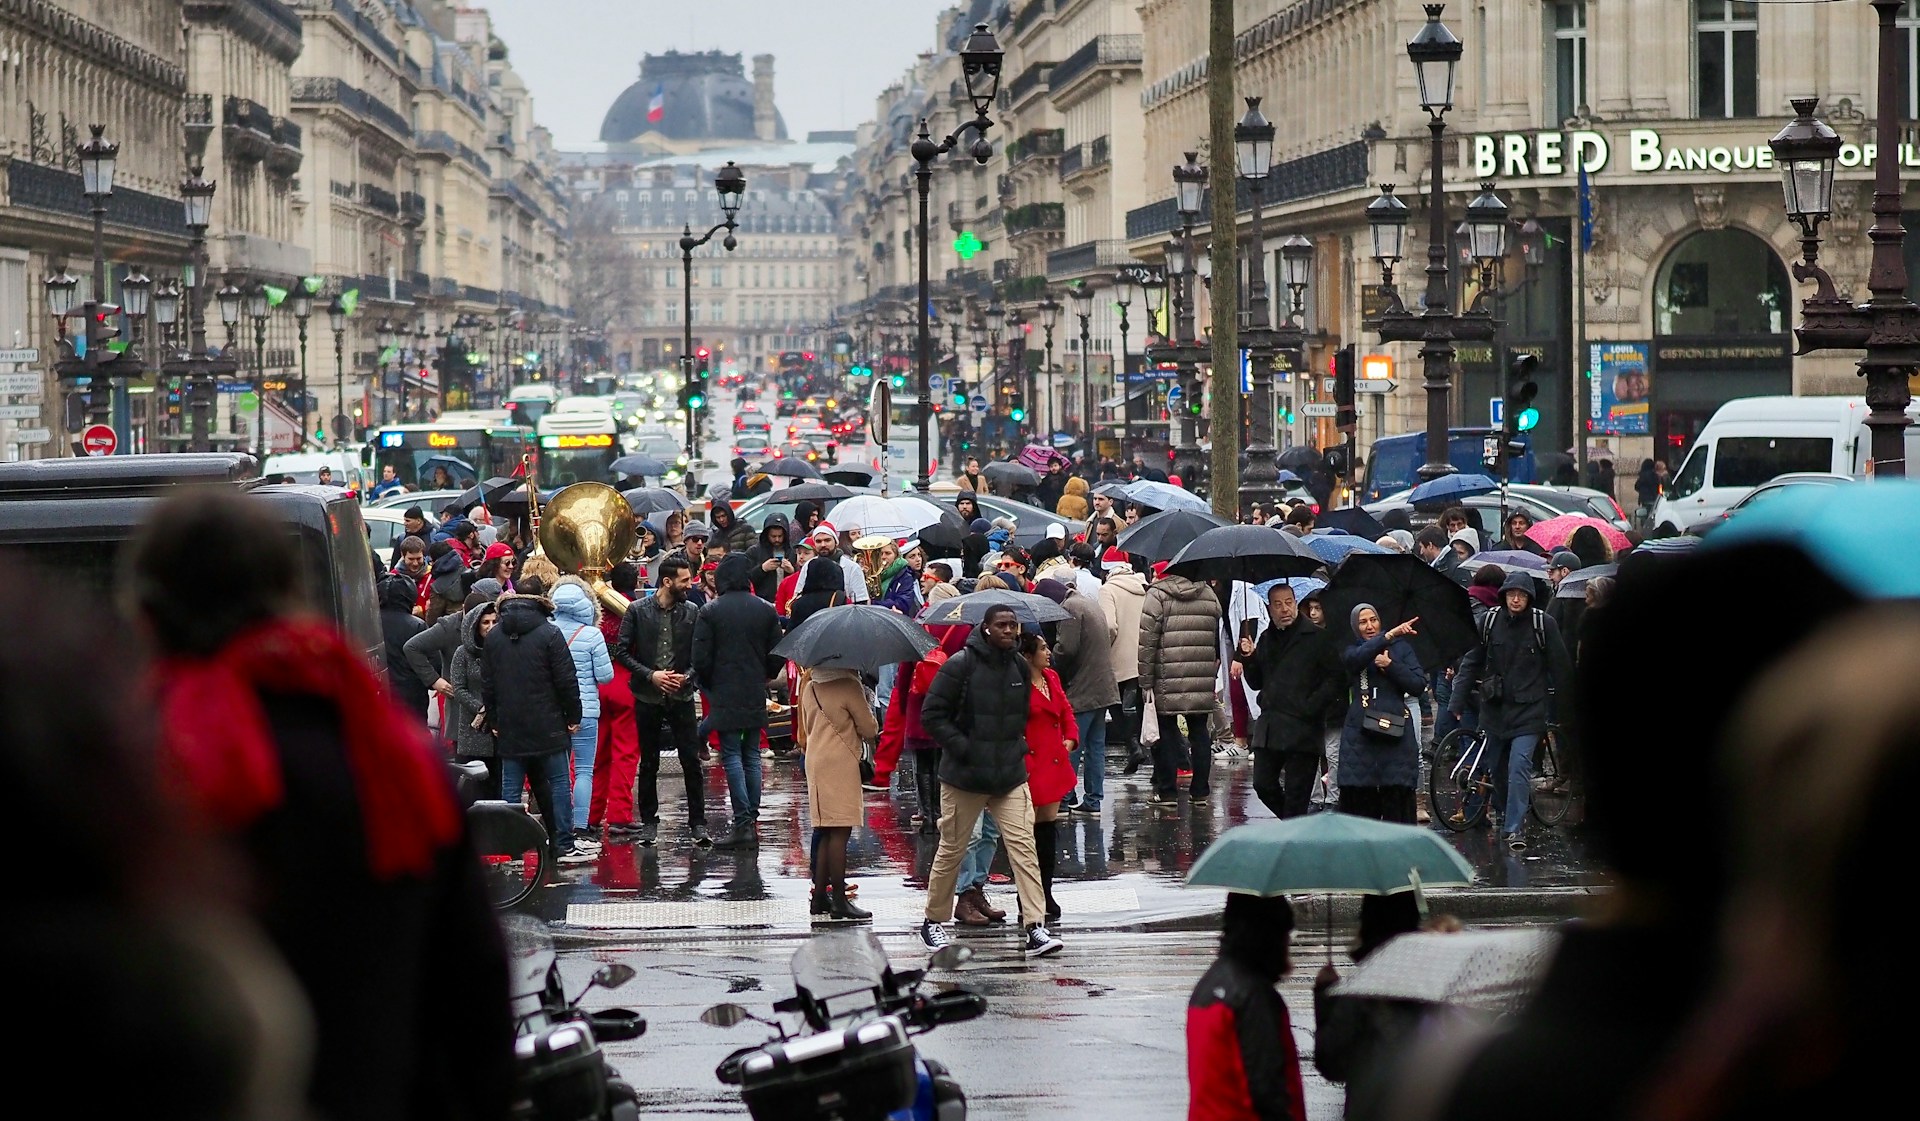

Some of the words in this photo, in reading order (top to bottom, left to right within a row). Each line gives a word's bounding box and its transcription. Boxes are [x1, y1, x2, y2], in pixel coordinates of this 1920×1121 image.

[1474, 131, 1609, 177] BRED
[385, 433, 403, 448] 95
[430, 432, 456, 447] Opéra
